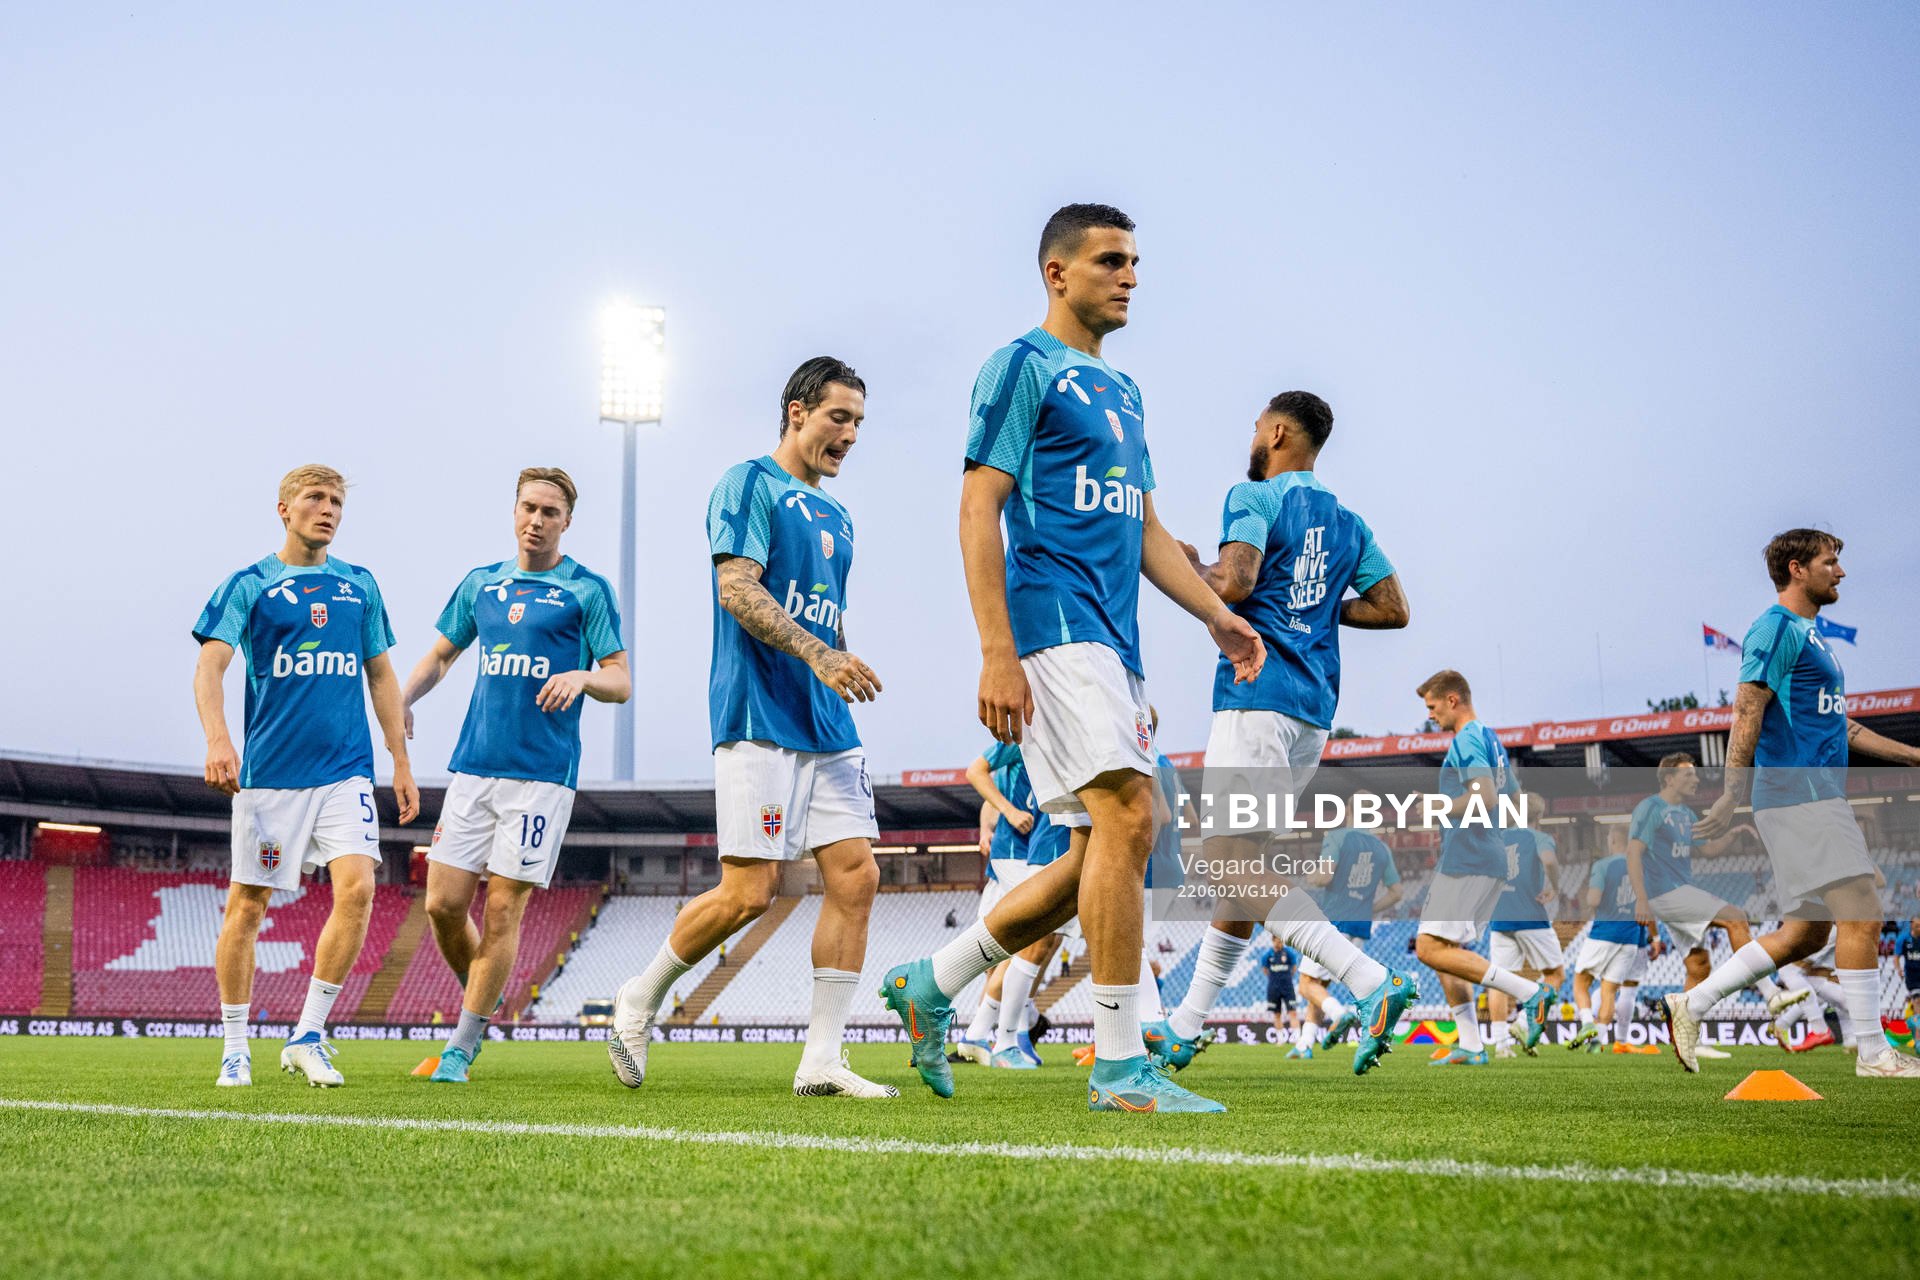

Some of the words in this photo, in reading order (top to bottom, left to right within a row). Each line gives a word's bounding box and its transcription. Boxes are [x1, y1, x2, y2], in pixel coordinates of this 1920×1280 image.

[359, 793, 374, 824] 5
[520, 814, 546, 849] 18
[1066, 1028, 1095, 1043] SNU
[1700, 1021, 1812, 1045] LEAGU
